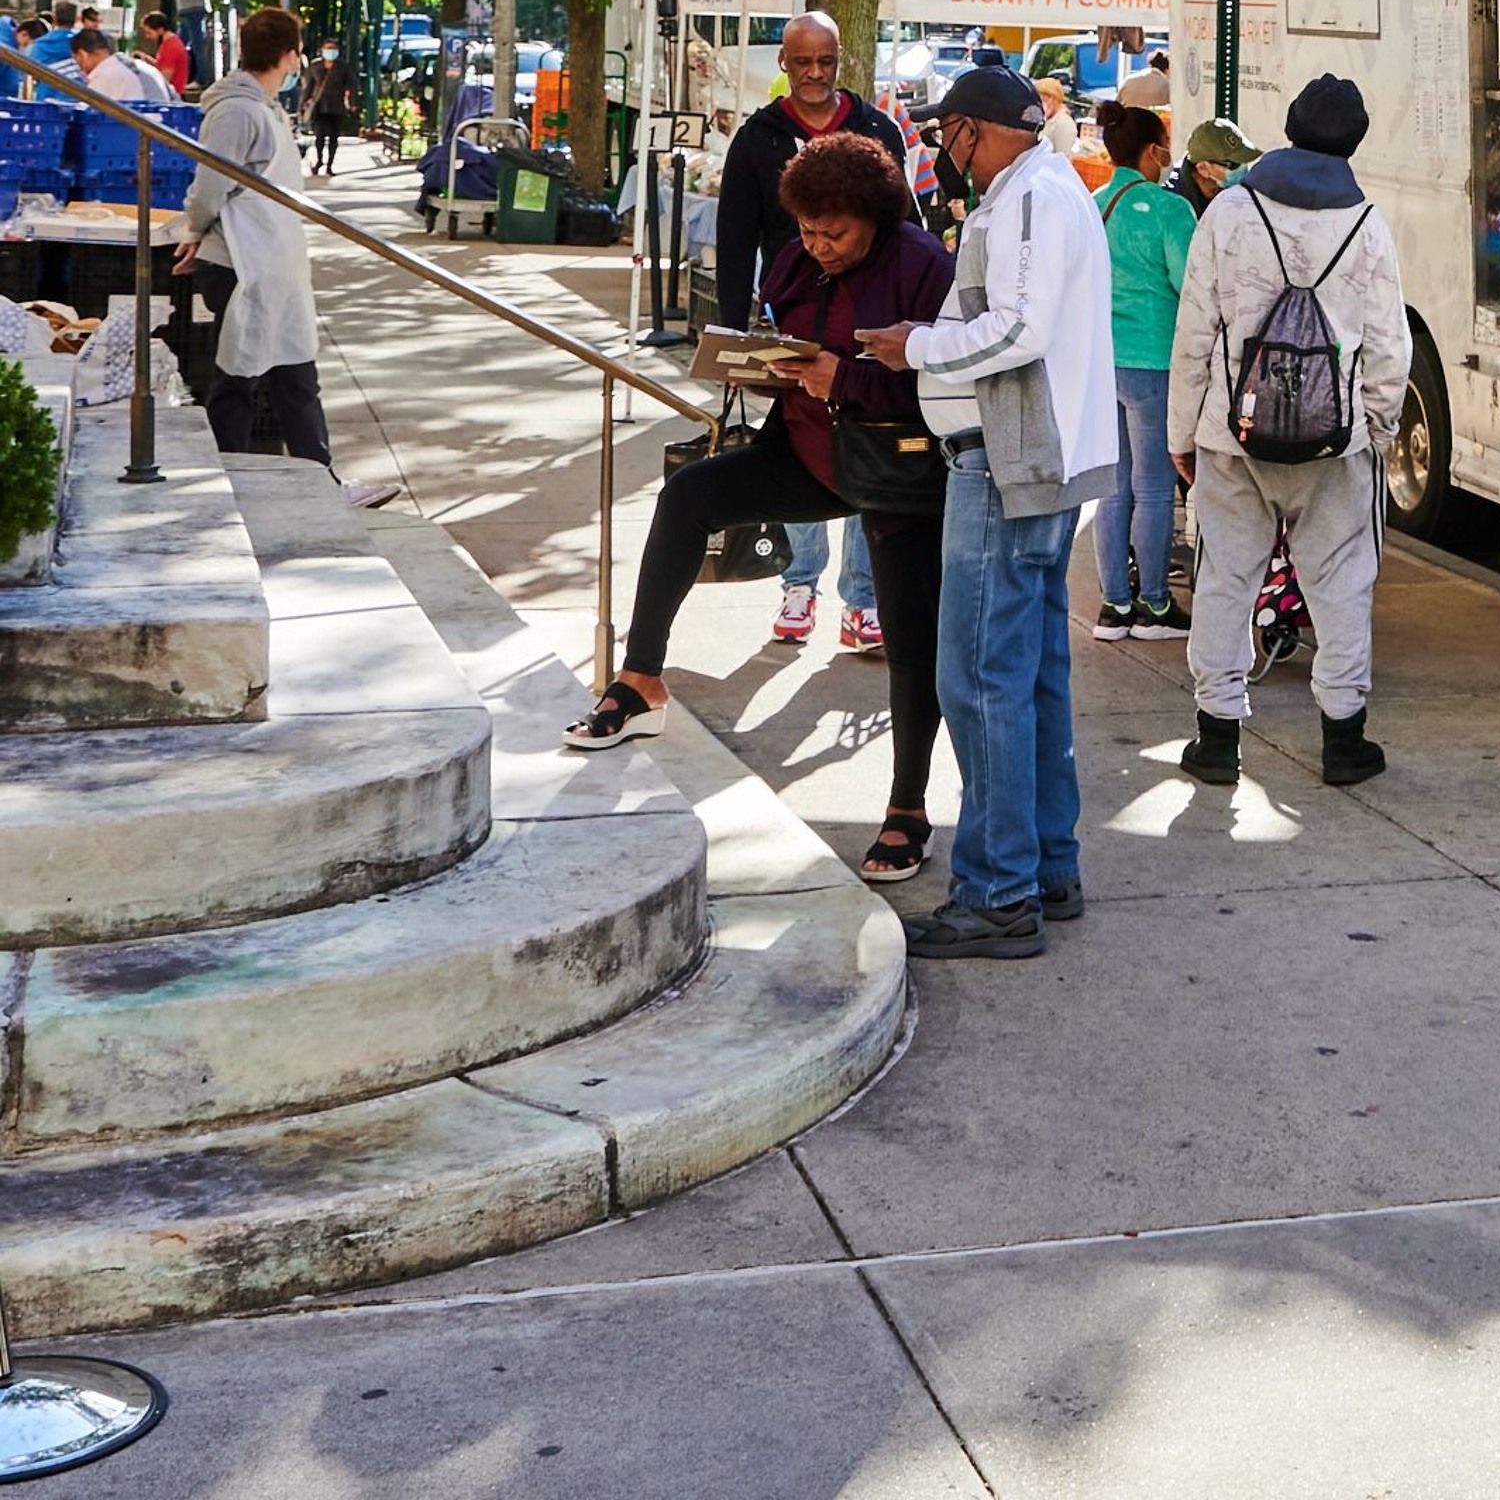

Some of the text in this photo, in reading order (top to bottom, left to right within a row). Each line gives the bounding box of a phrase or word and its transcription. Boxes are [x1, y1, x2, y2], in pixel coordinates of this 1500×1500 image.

[1184, 16, 1278, 45] MOBIL ARKET
[675, 121, 690, 143] 2
[1016, 245, 1031, 289] Calvin
